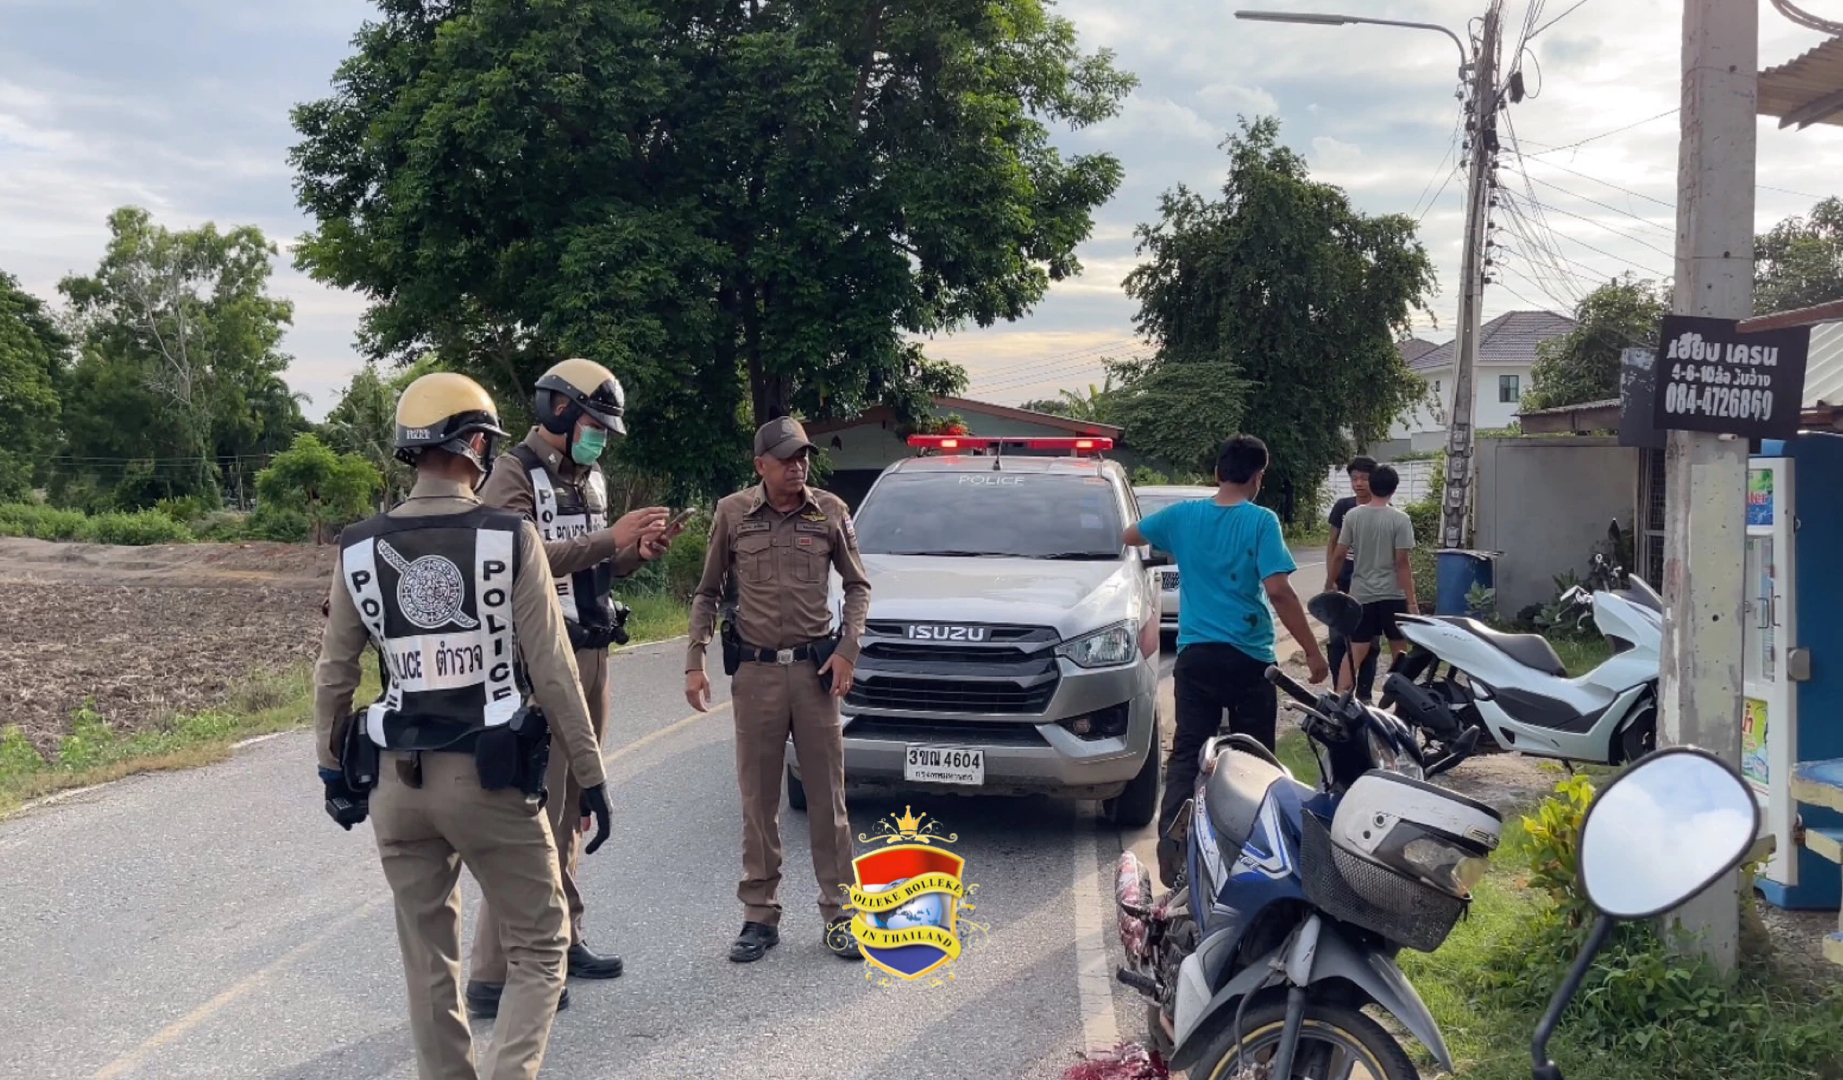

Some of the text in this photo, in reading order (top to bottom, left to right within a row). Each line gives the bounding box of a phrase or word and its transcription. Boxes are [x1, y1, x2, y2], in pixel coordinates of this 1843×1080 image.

[1726, 343, 1779, 366] เครน
[1665, 382, 1773, 422] 084-4726869
[959, 475, 1025, 487] POLICE
[483, 560, 511, 701] POLICE
[908, 625, 985, 641] ISUZU
[436, 641, 483, 677] ตำรวจ
[944, 751, 980, 769] 4604
